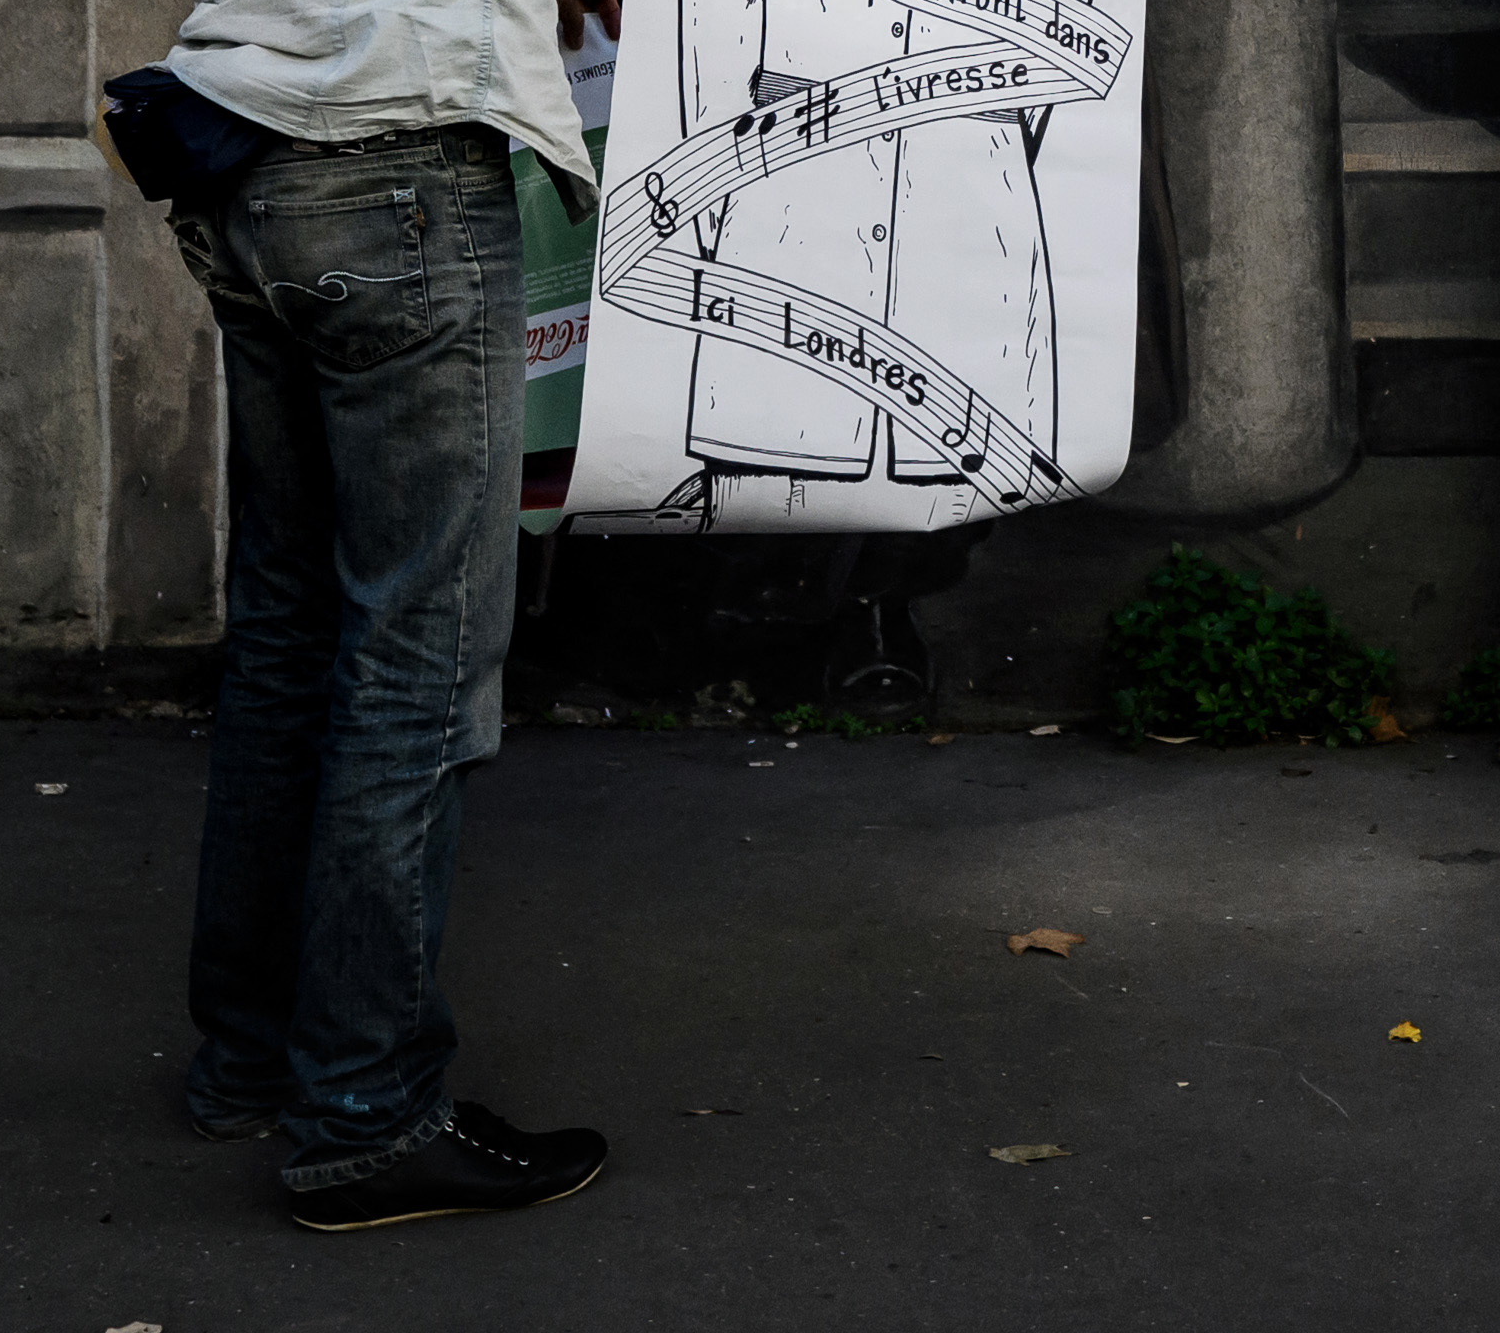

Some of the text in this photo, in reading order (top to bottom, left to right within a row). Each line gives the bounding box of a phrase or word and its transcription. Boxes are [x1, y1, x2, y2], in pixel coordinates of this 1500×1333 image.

[1045, 1, 1111, 65] dans
[873, 60, 1031, 113] l'ivresse
[691, 269, 735, 328] Ici
[783, 300, 928, 407] Londres
